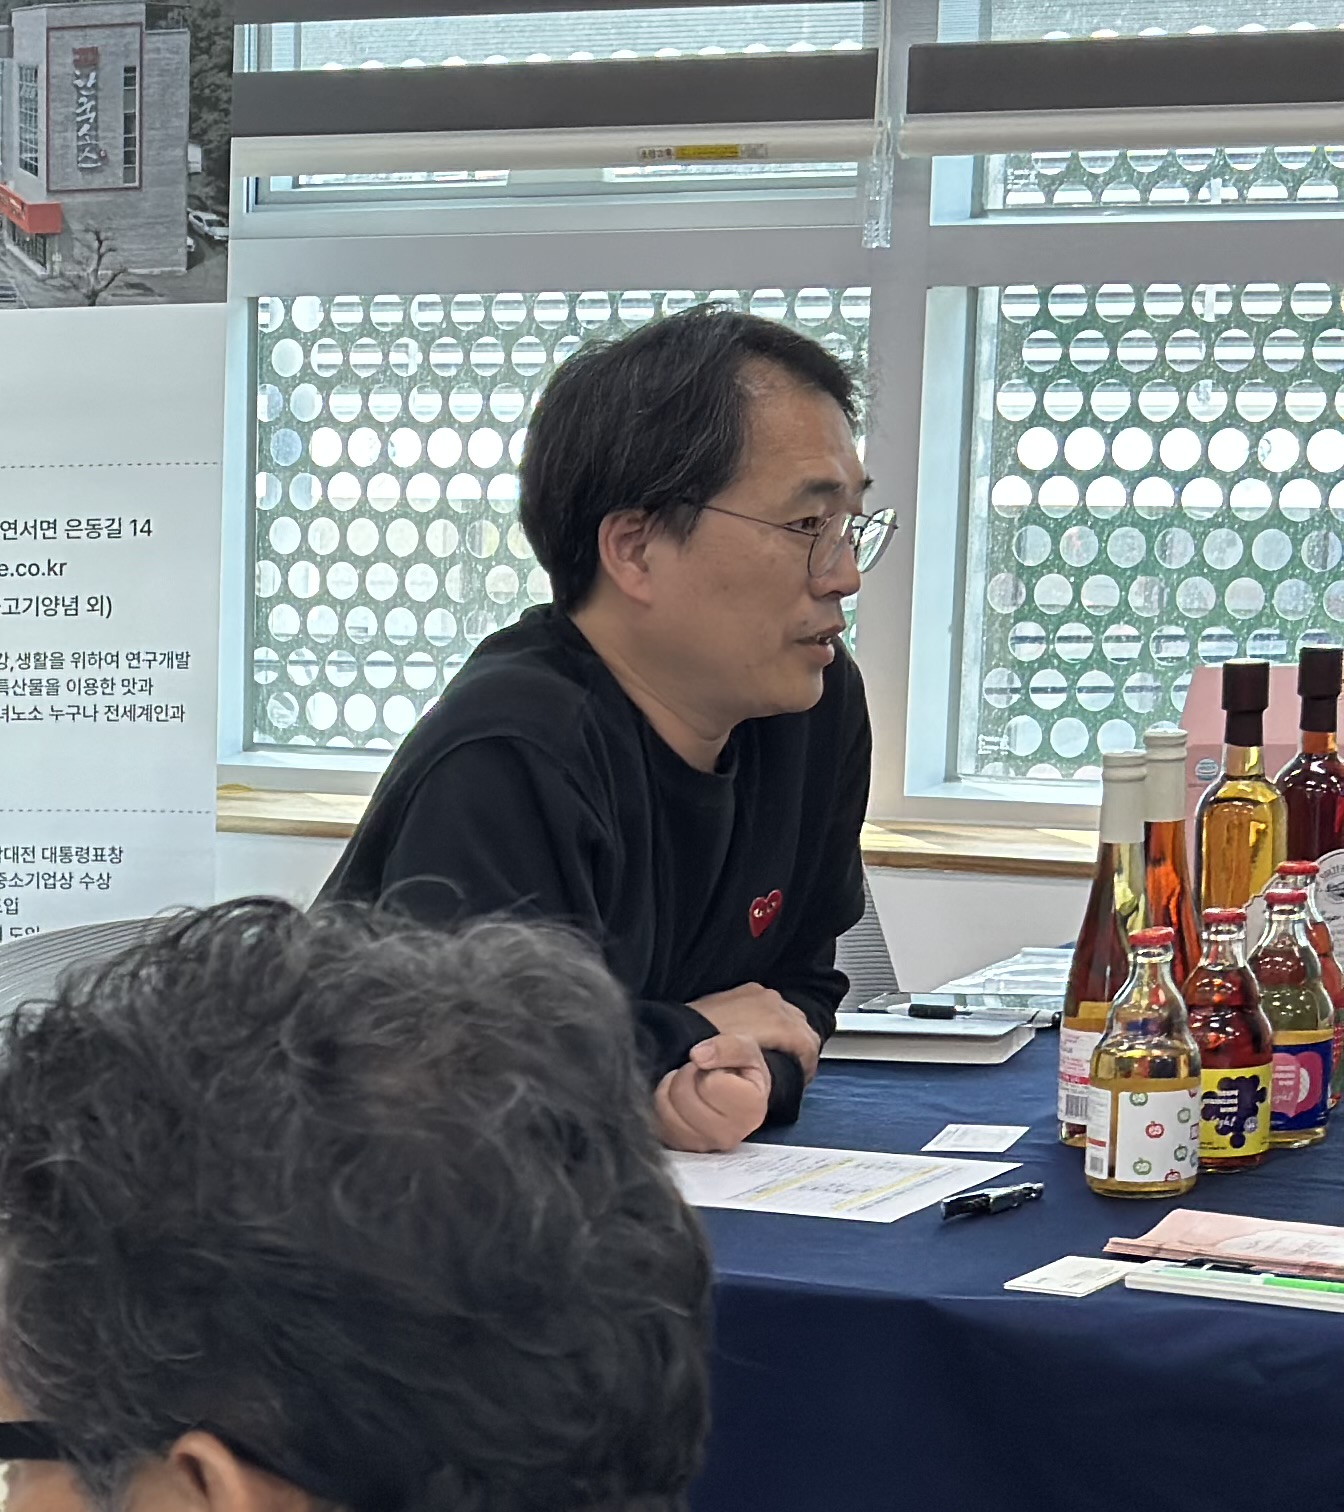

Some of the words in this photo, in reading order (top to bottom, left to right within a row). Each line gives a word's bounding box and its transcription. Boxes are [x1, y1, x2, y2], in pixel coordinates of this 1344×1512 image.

[0, 518, 58, 541] 연서면
[64, 518, 123, 540] 은동길
[129, 518, 153, 538] 14
[86, 595, 113, 619] 외)
[70, 651, 120, 672] 위하여
[125, 651, 190, 672] 연구개발
[66, 678, 115, 697] 이용한
[121, 678, 153, 697] 맛과
[49, 705, 99, 723] 누구나
[104, 705, 184, 723] 전세계인과
[42, 846, 123, 864] 대통령표창
[79, 872, 111, 889] 수상
